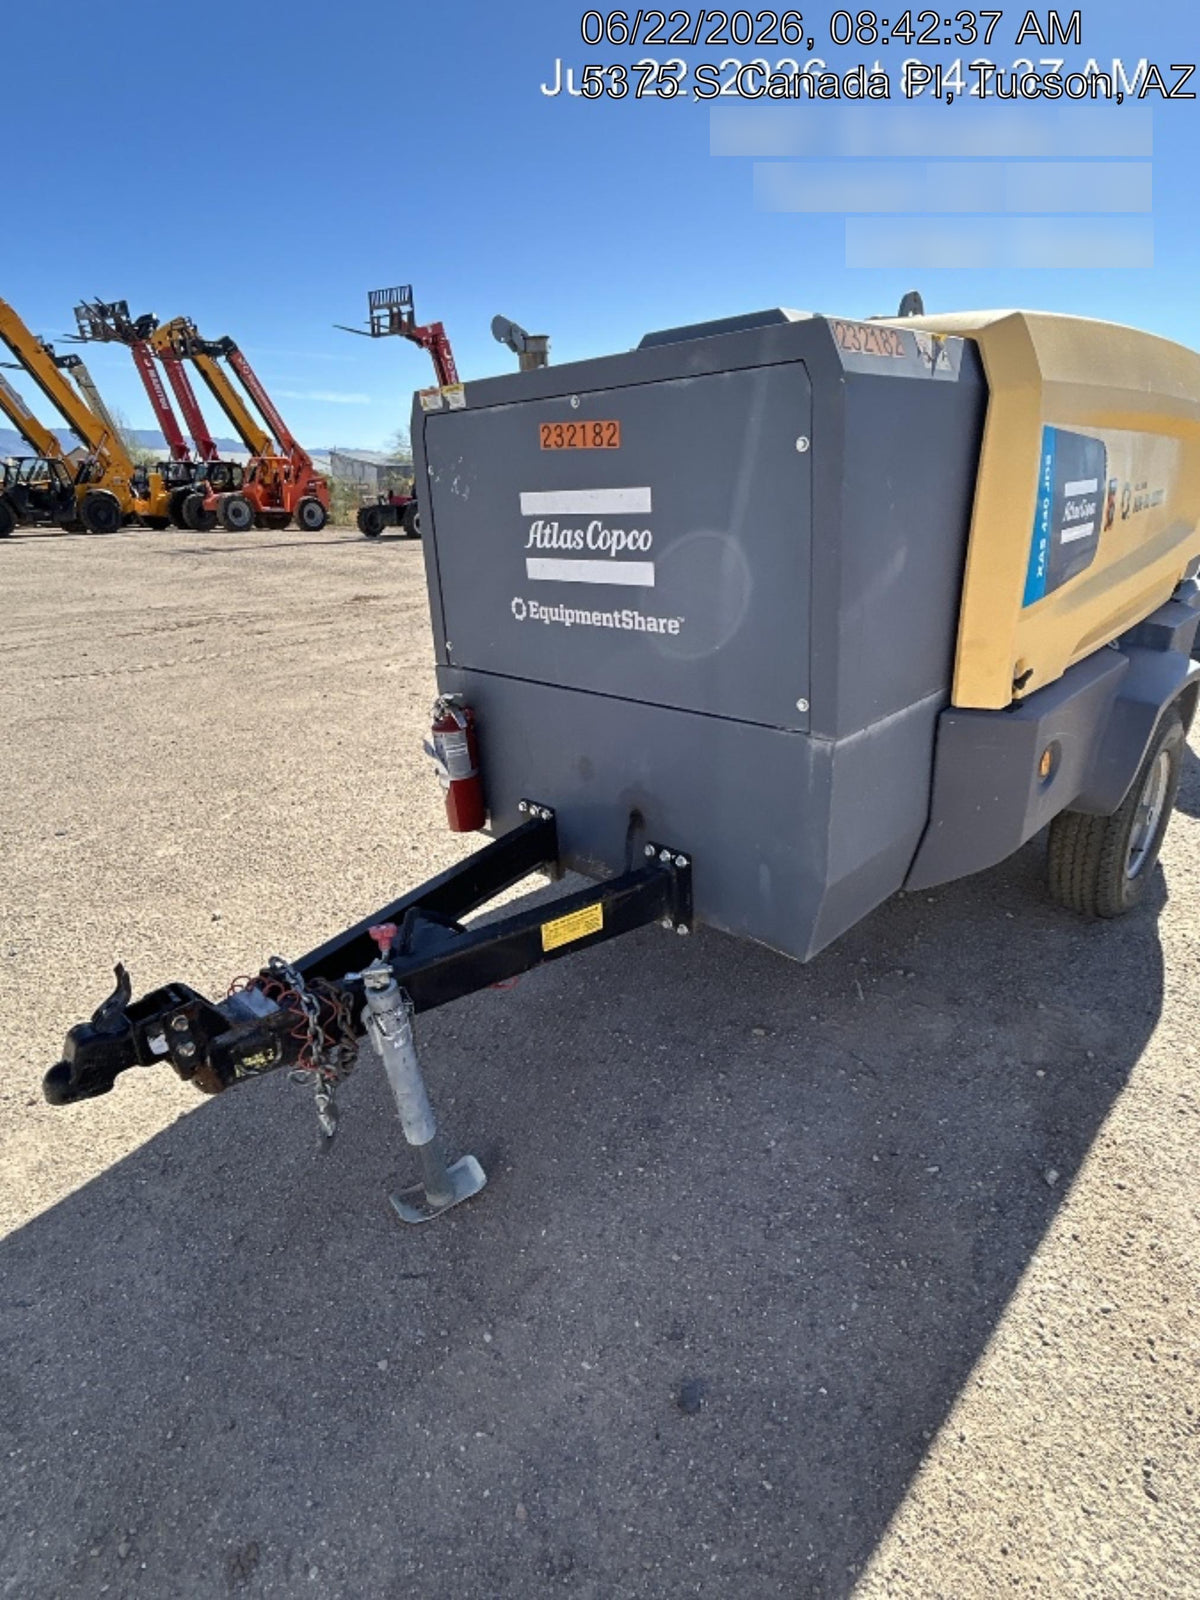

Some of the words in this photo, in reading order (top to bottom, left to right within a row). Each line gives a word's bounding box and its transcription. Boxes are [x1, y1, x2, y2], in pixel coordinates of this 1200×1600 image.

[833, 321, 906, 356] 232182
[541, 421, 618, 449] 232182
[524, 520, 585, 550] Atlas
[586, 520, 653, 557] Copco
[527, 600, 680, 635] EquipmentShare
